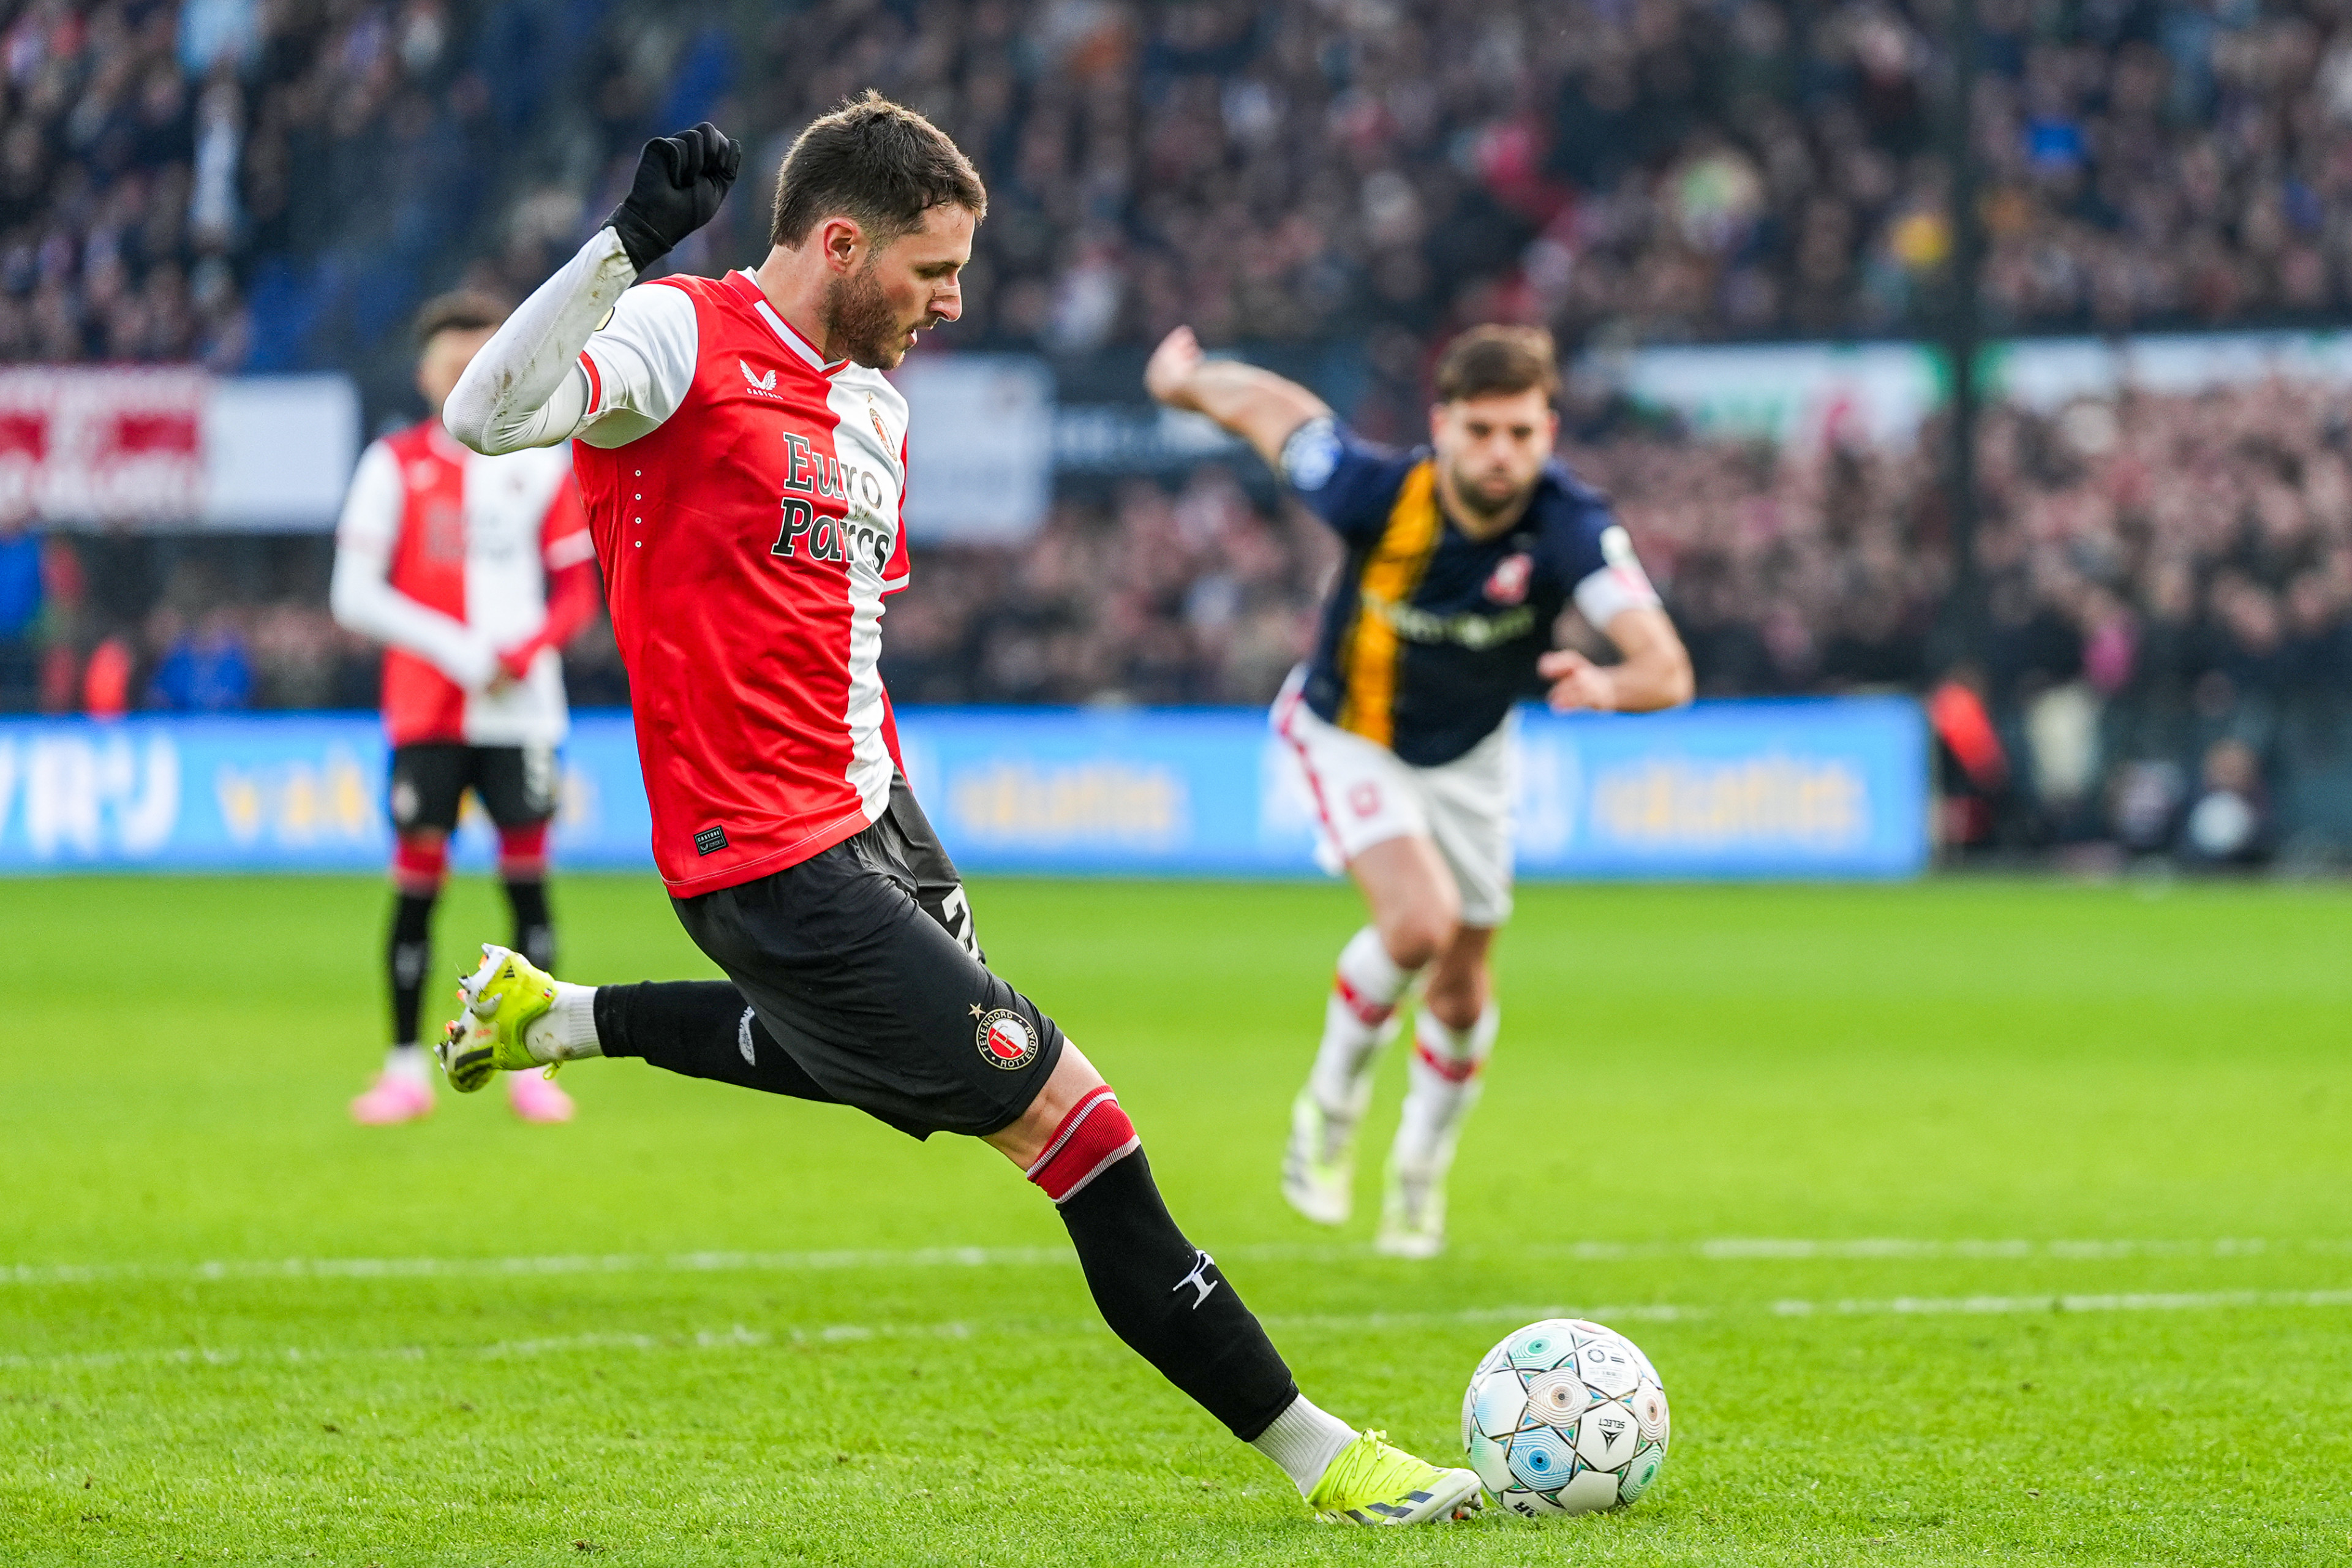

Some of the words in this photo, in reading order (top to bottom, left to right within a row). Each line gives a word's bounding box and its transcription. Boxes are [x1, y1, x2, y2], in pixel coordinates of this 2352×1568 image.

[783, 431, 882, 510] Euro
[771, 497, 891, 575] Parcs
[979, 1011, 1013, 1052] FEYENOORD
[1000, 1026, 1037, 1068] ROTTERDAM
[1598, 1418, 1626, 1429] SELECT
